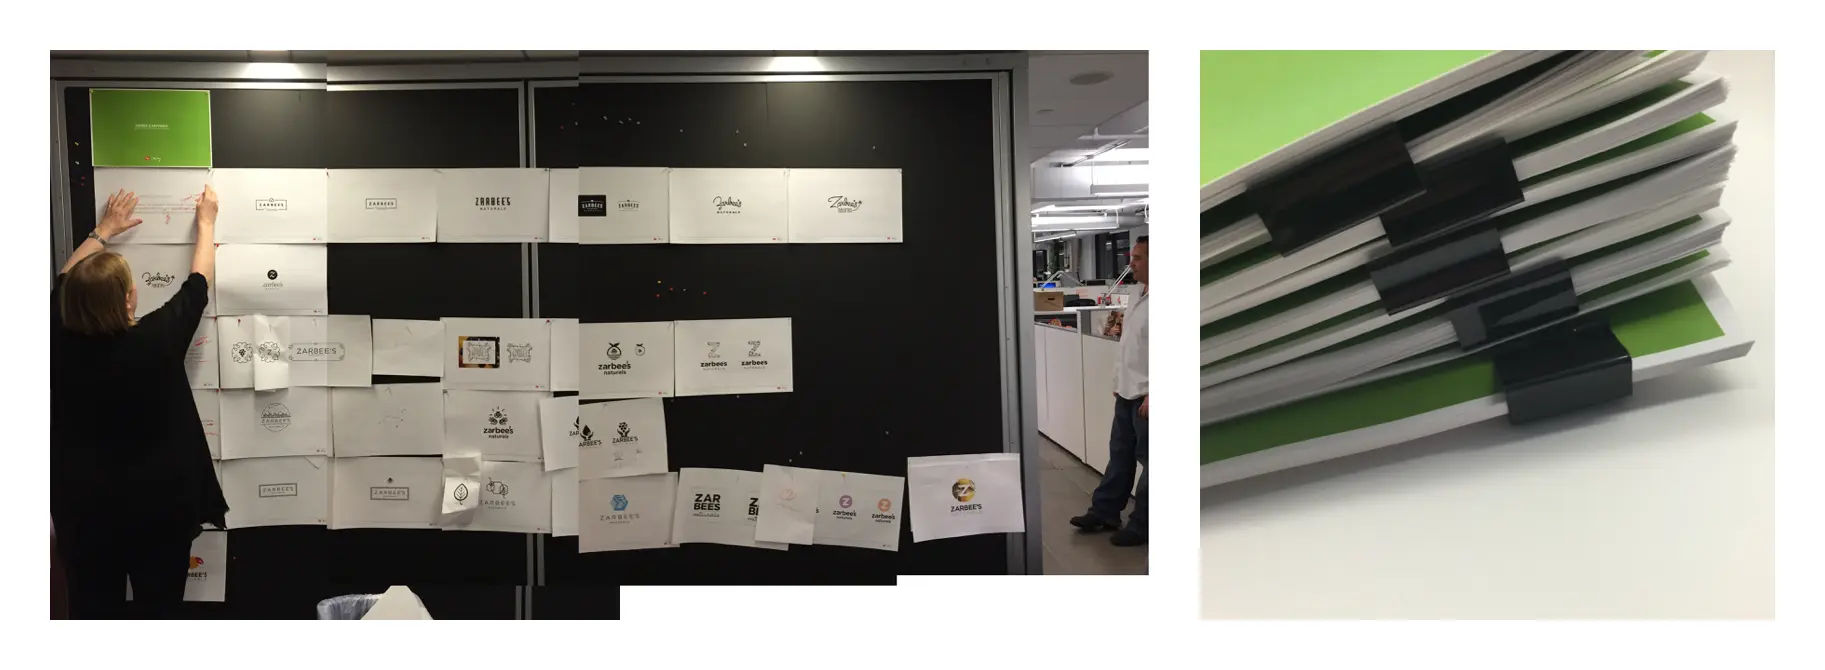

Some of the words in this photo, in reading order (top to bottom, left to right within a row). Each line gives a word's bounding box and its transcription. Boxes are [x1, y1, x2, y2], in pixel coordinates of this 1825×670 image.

[598, 361, 631, 370] zarbee's
[483, 426, 513, 434] zarbee's
[957, 484, 971, 497] Z
[694, 494, 721, 502] ZAR
[951, 504, 982, 512] ZARBEE'S
